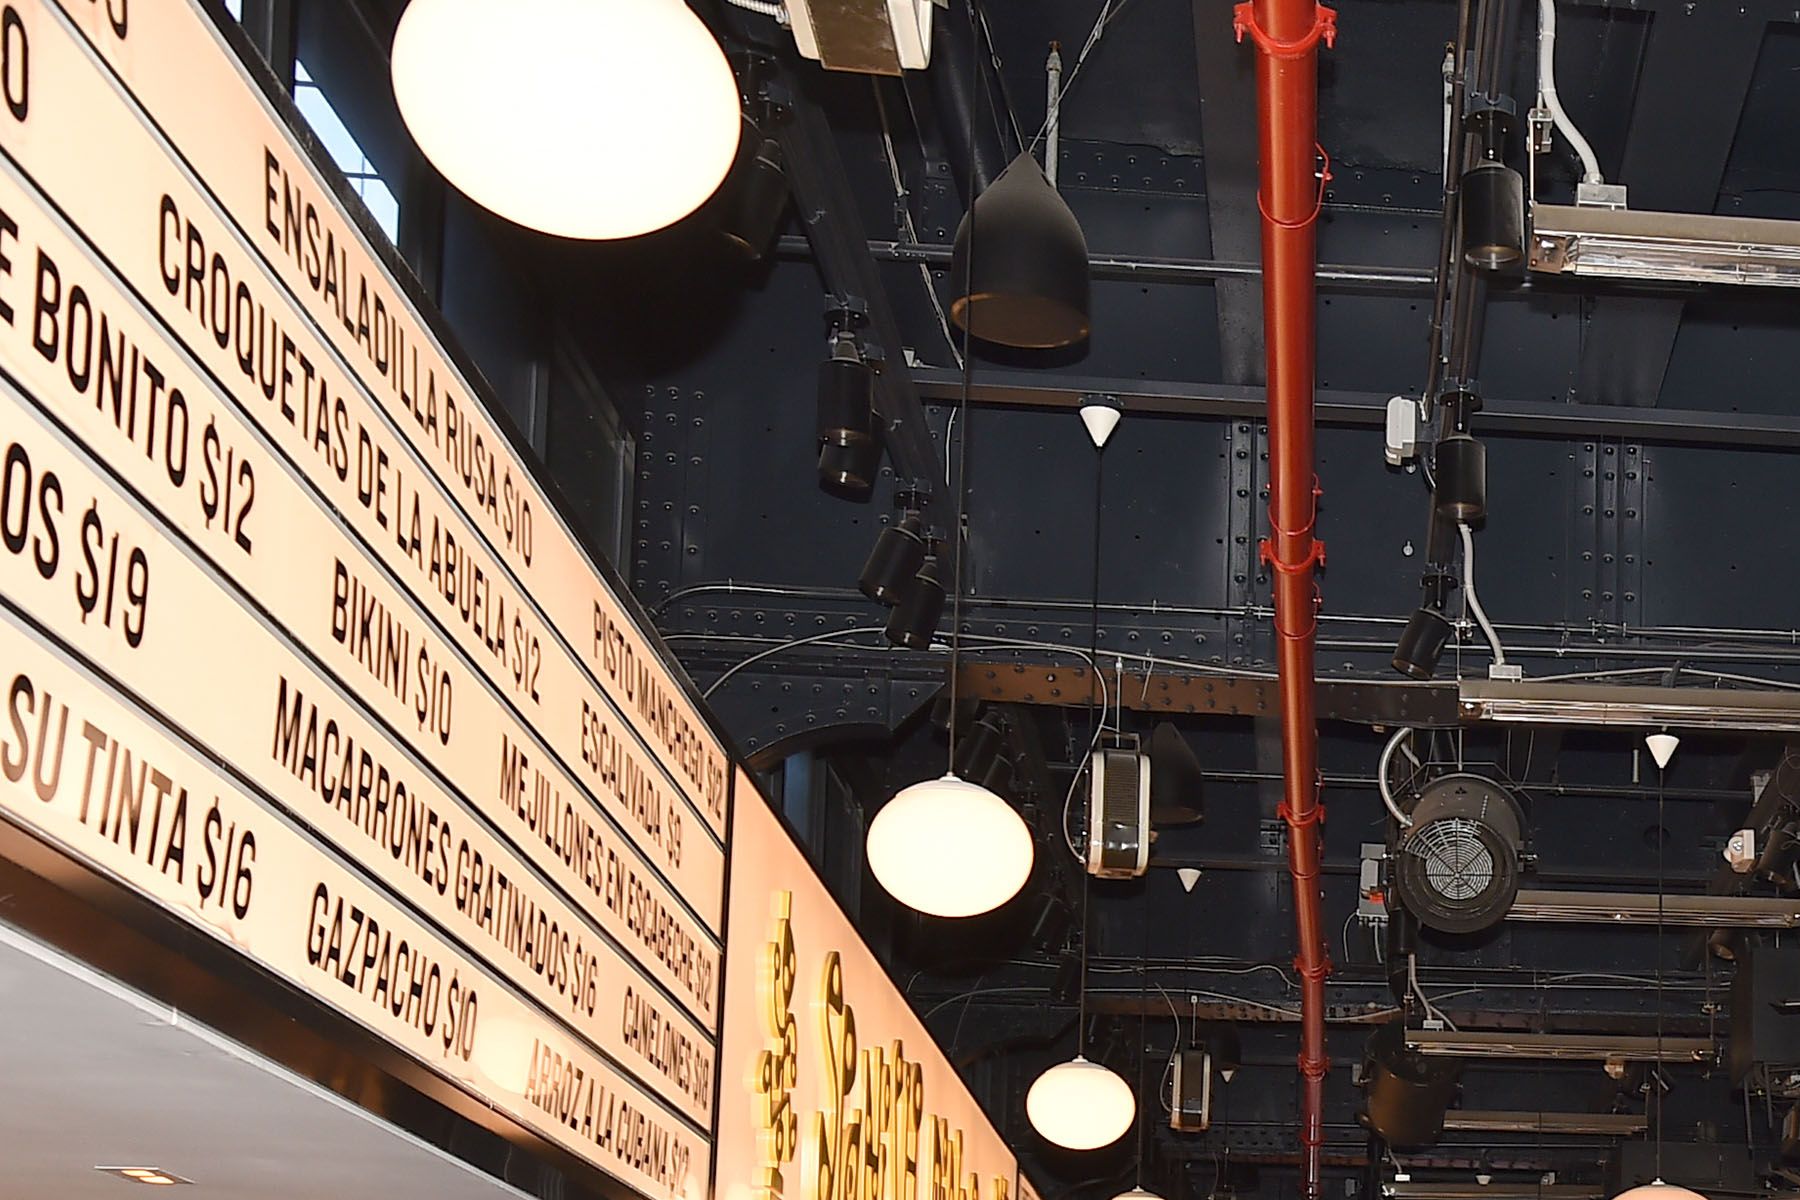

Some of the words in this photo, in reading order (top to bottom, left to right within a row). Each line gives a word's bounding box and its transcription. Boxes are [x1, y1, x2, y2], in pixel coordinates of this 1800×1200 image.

[32, 245, 189, 488] BONITO
[199, 413, 256, 556] $12
[159, 193, 349, 482] CROQUETAS
[357, 422, 389, 531] DE
[396, 470, 423, 571] LA
[428, 514, 507, 668] ABUELA
[511, 607, 541, 706] $12
[263, 145, 439, 449] ENSALADILLA
[445, 392, 499, 527] RUSA
[502, 464, 533, 568] $10
[75, 497, 149, 649] $19
[331, 556, 409, 705] BIKINI
[415, 638, 452, 746] $10
[1, 673, 69, 802] SU
[79, 719, 188, 885] TINTA
[197, 796, 256, 920] $16
[581, 697, 662, 848] ESCALIVADA
[593, 598, 634, 703] PISTO
[637, 656, 703, 794] MANCHEGO
[705, 748, 723, 821] $12
[272, 674, 451, 896] MACARRONES
[455, 838, 569, 996] GRATINADOS
[571, 935, 598, 1018] $16
[500, 732, 603, 897] MEJILLONES
[606, 847, 625, 920] EN
[627, 870, 694, 993] ESCABECHE
[695, 943, 711, 1012] $12
[305, 882, 441, 1037] GAZPACHO
[443, 969, 478, 1062] $10
[622, 985, 692, 1095] CANELONES
[524, 1038, 584, 1131] ARROZ
[581, 1077, 595, 1140] A
[596, 1084, 615, 1153] LA
[616, 1100, 669, 1186] CUBANA
